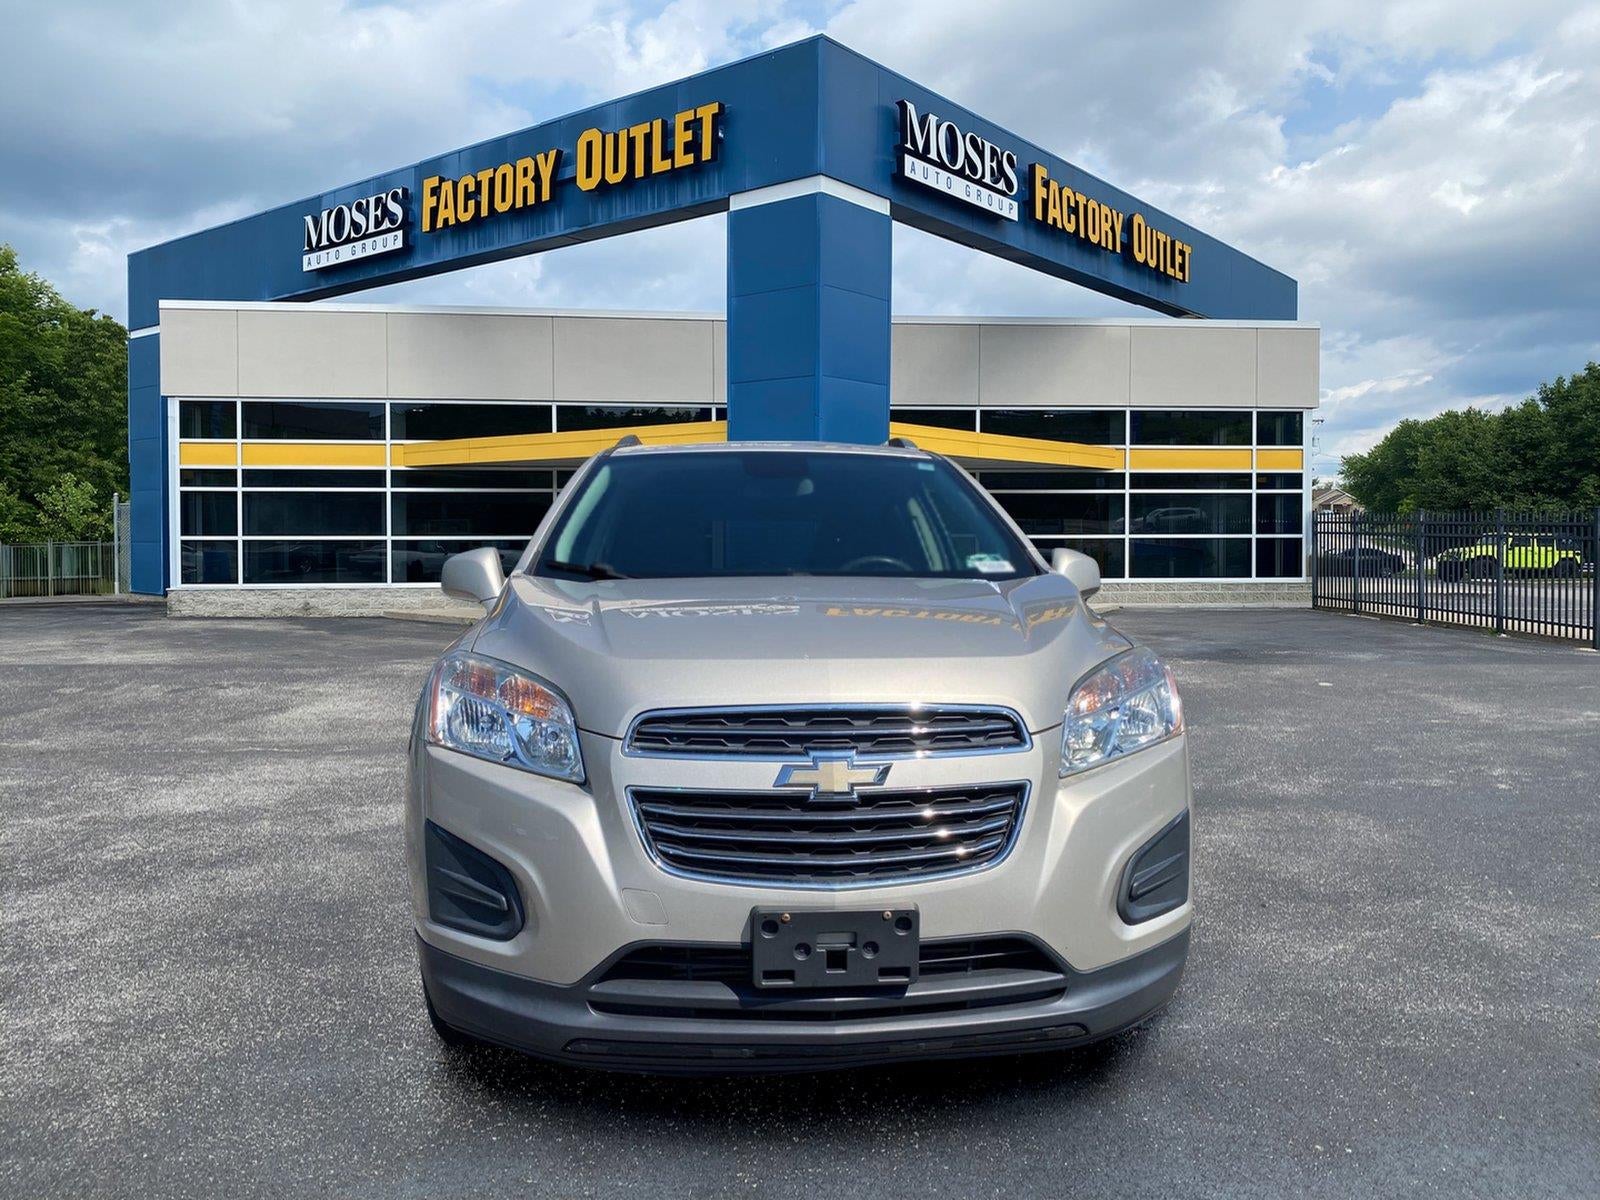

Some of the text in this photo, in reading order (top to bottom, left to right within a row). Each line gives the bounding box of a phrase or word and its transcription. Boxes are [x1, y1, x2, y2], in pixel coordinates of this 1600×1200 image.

[421, 101, 720, 233] FACTORY OUTLET
[904, 99, 1019, 196] MOSES
[909, 160, 1015, 215] AUTO GROUP
[303, 187, 403, 252] MOSES
[306, 234, 400, 268] AUTO GROUP
[1034, 163, 1193, 283] FACTORY OUTLET
